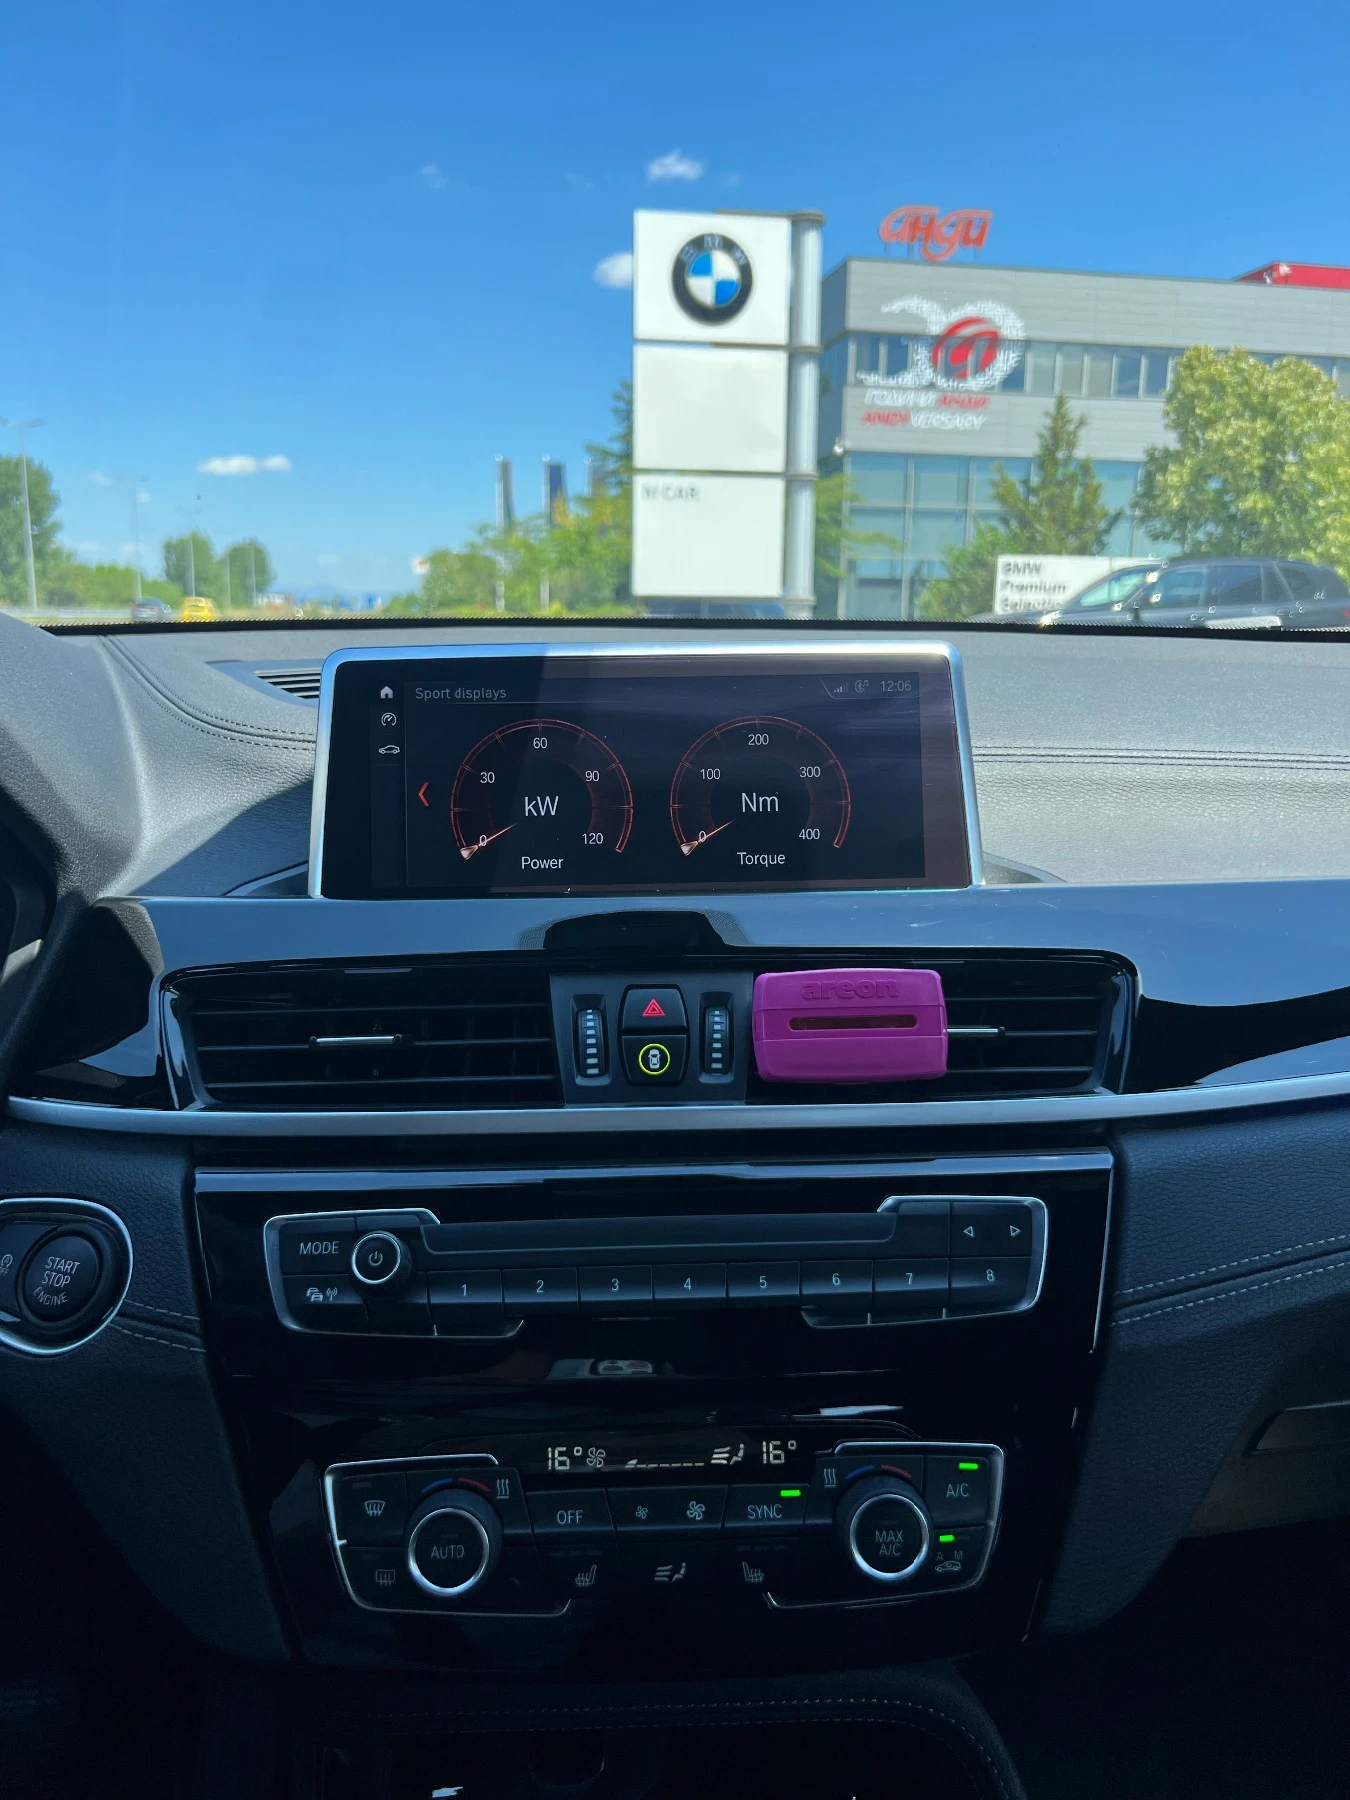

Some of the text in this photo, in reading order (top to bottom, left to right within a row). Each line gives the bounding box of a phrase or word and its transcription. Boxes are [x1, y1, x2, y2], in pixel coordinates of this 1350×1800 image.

[1001, 562, 1042, 575] BMW
[1001, 580, 1066, 593] Premium
[880, 680, 912, 692] 12:06
[415, 687, 507, 701] Sport displays
[533, 737, 548, 749] 60
[748, 734, 770, 746] 200
[480, 772, 496, 784] 30
[585, 770, 600, 782] 90
[700, 768, 721, 780] 100
[799, 766, 821, 778] 300
[524, 796, 559, 817] kW
[741, 792, 779, 813] Nm
[479, 834, 488, 847] 0
[582, 832, 604, 845] 120
[698, 831, 707, 843] 0
[798, 828, 821, 840] 400
[521, 856, 564, 869] Power
[737, 852, 786, 868] Torque
[802, 979, 898, 1000] areon
[300, 1240, 340, 1256] MODE
[46, 1256, 81, 1274] START
[42, 1271, 71, 1288] STOP
[759, 1275, 768, 1289] 5
[832, 1272, 841, 1287] 6
[905, 1272, 914, 1285] 7
[986, 1269, 995, 1283] 8
[461, 1283, 468, 1297] 1
[536, 1279, 545, 1294] 2
[611, 1278, 620, 1292] 3
[683, 1277, 692, 1291] 4
[33, 1286, 69, 1306] ENGINE
[946, 1482, 970, 1498] A/C
[556, 1509, 584, 1525] OFF
[747, 1503, 783, 1519] SYNC
[874, 1529, 905, 1543] MAX
[430, 1544, 465, 1559] AUTO
[879, 1542, 901, 1556] A/C
